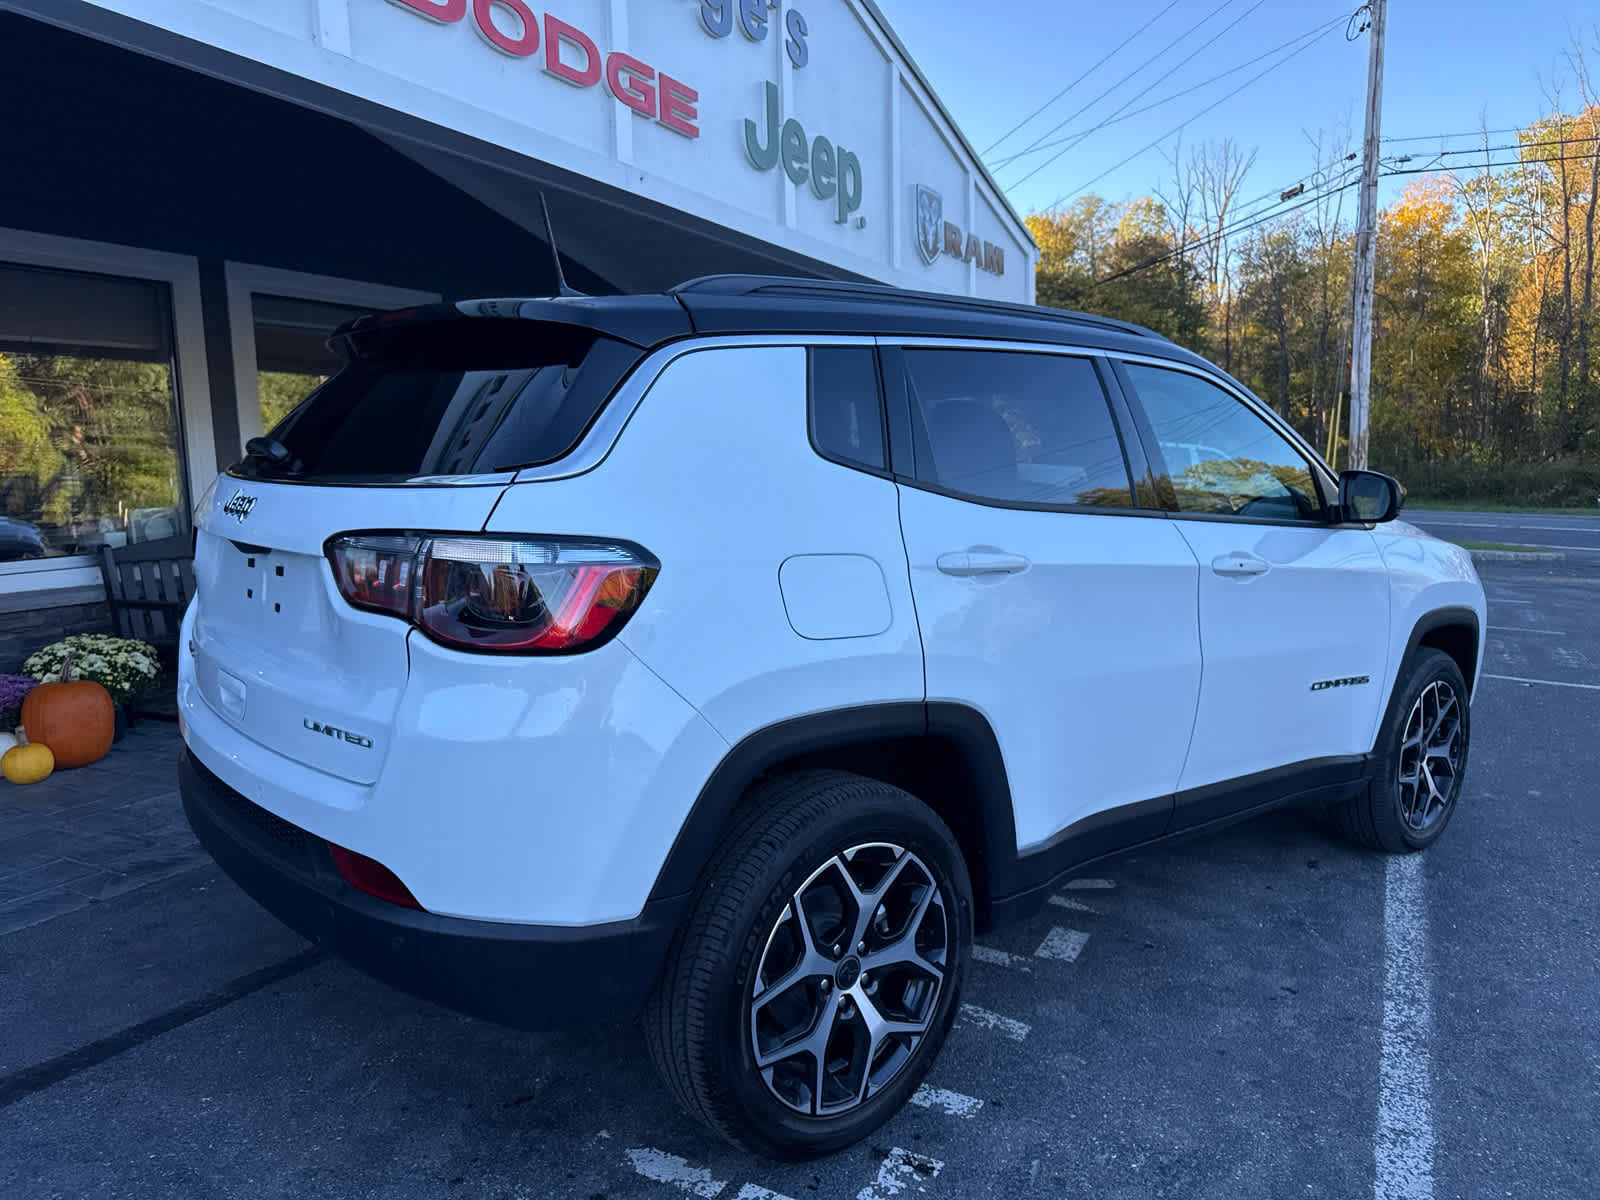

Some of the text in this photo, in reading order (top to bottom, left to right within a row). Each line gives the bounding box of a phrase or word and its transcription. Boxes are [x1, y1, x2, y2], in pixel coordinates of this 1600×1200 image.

[384, 0, 699, 138] ODGE
[744, 79, 862, 225] Jeep
[942, 220, 1005, 276] RAM
[223, 488, 258, 523] Jeep
[1310, 674, 1370, 691] COMPASS
[303, 717, 373, 749] LIMITED
